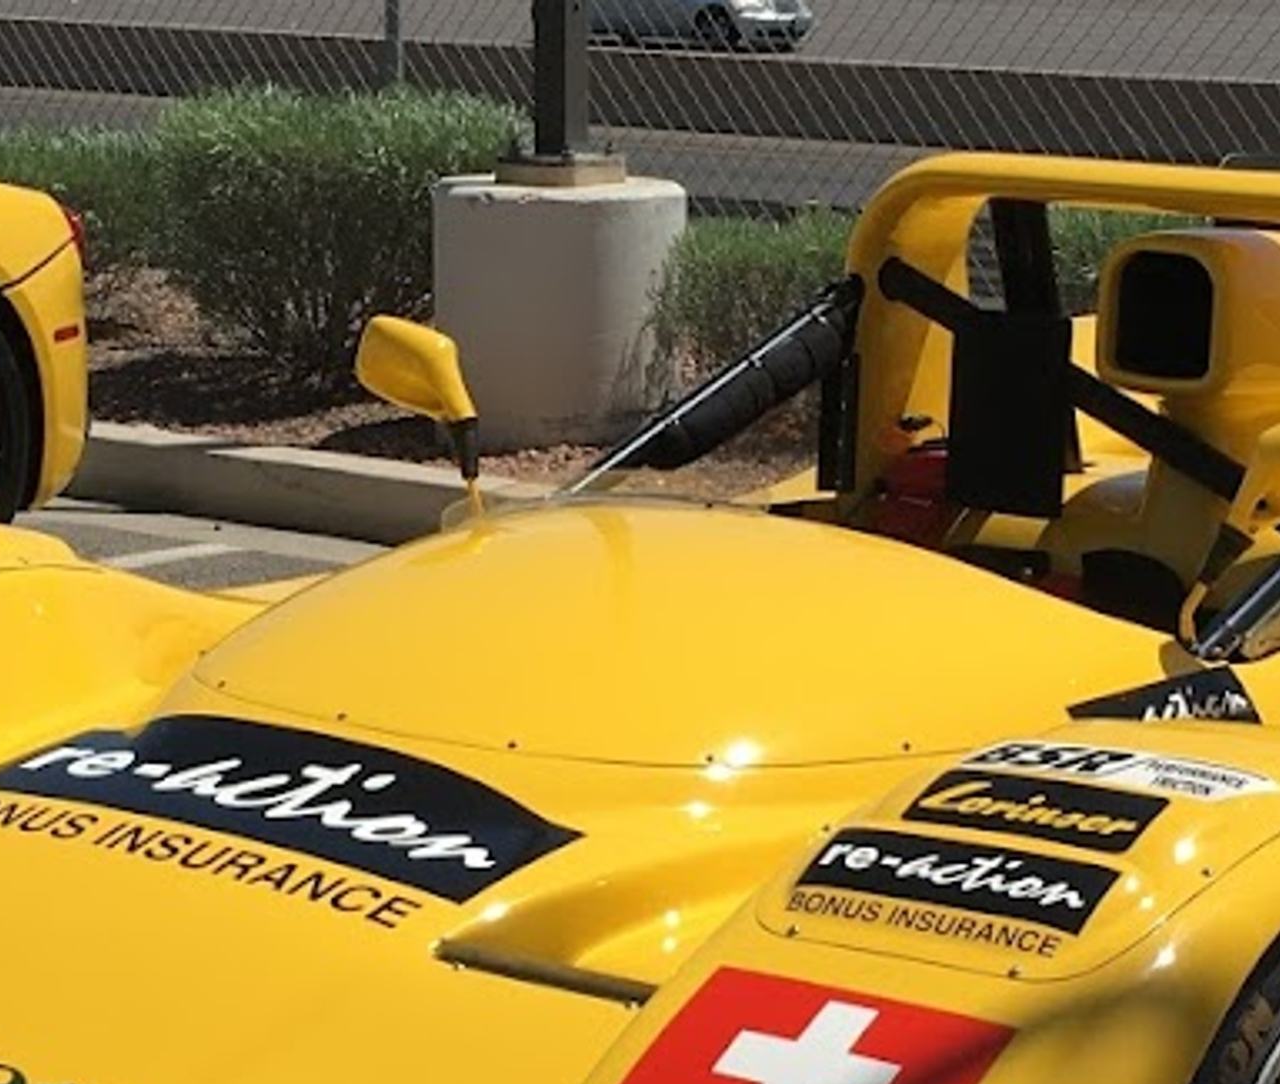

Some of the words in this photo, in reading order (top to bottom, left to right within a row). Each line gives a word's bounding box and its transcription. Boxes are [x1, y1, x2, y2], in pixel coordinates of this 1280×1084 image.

[95, 822, 424, 930] INSURANCE
[818, 841, 1086, 911] re-action
[787, 889, 882, 925] BONUS
[886, 896, 1062, 959] INSURANCE
